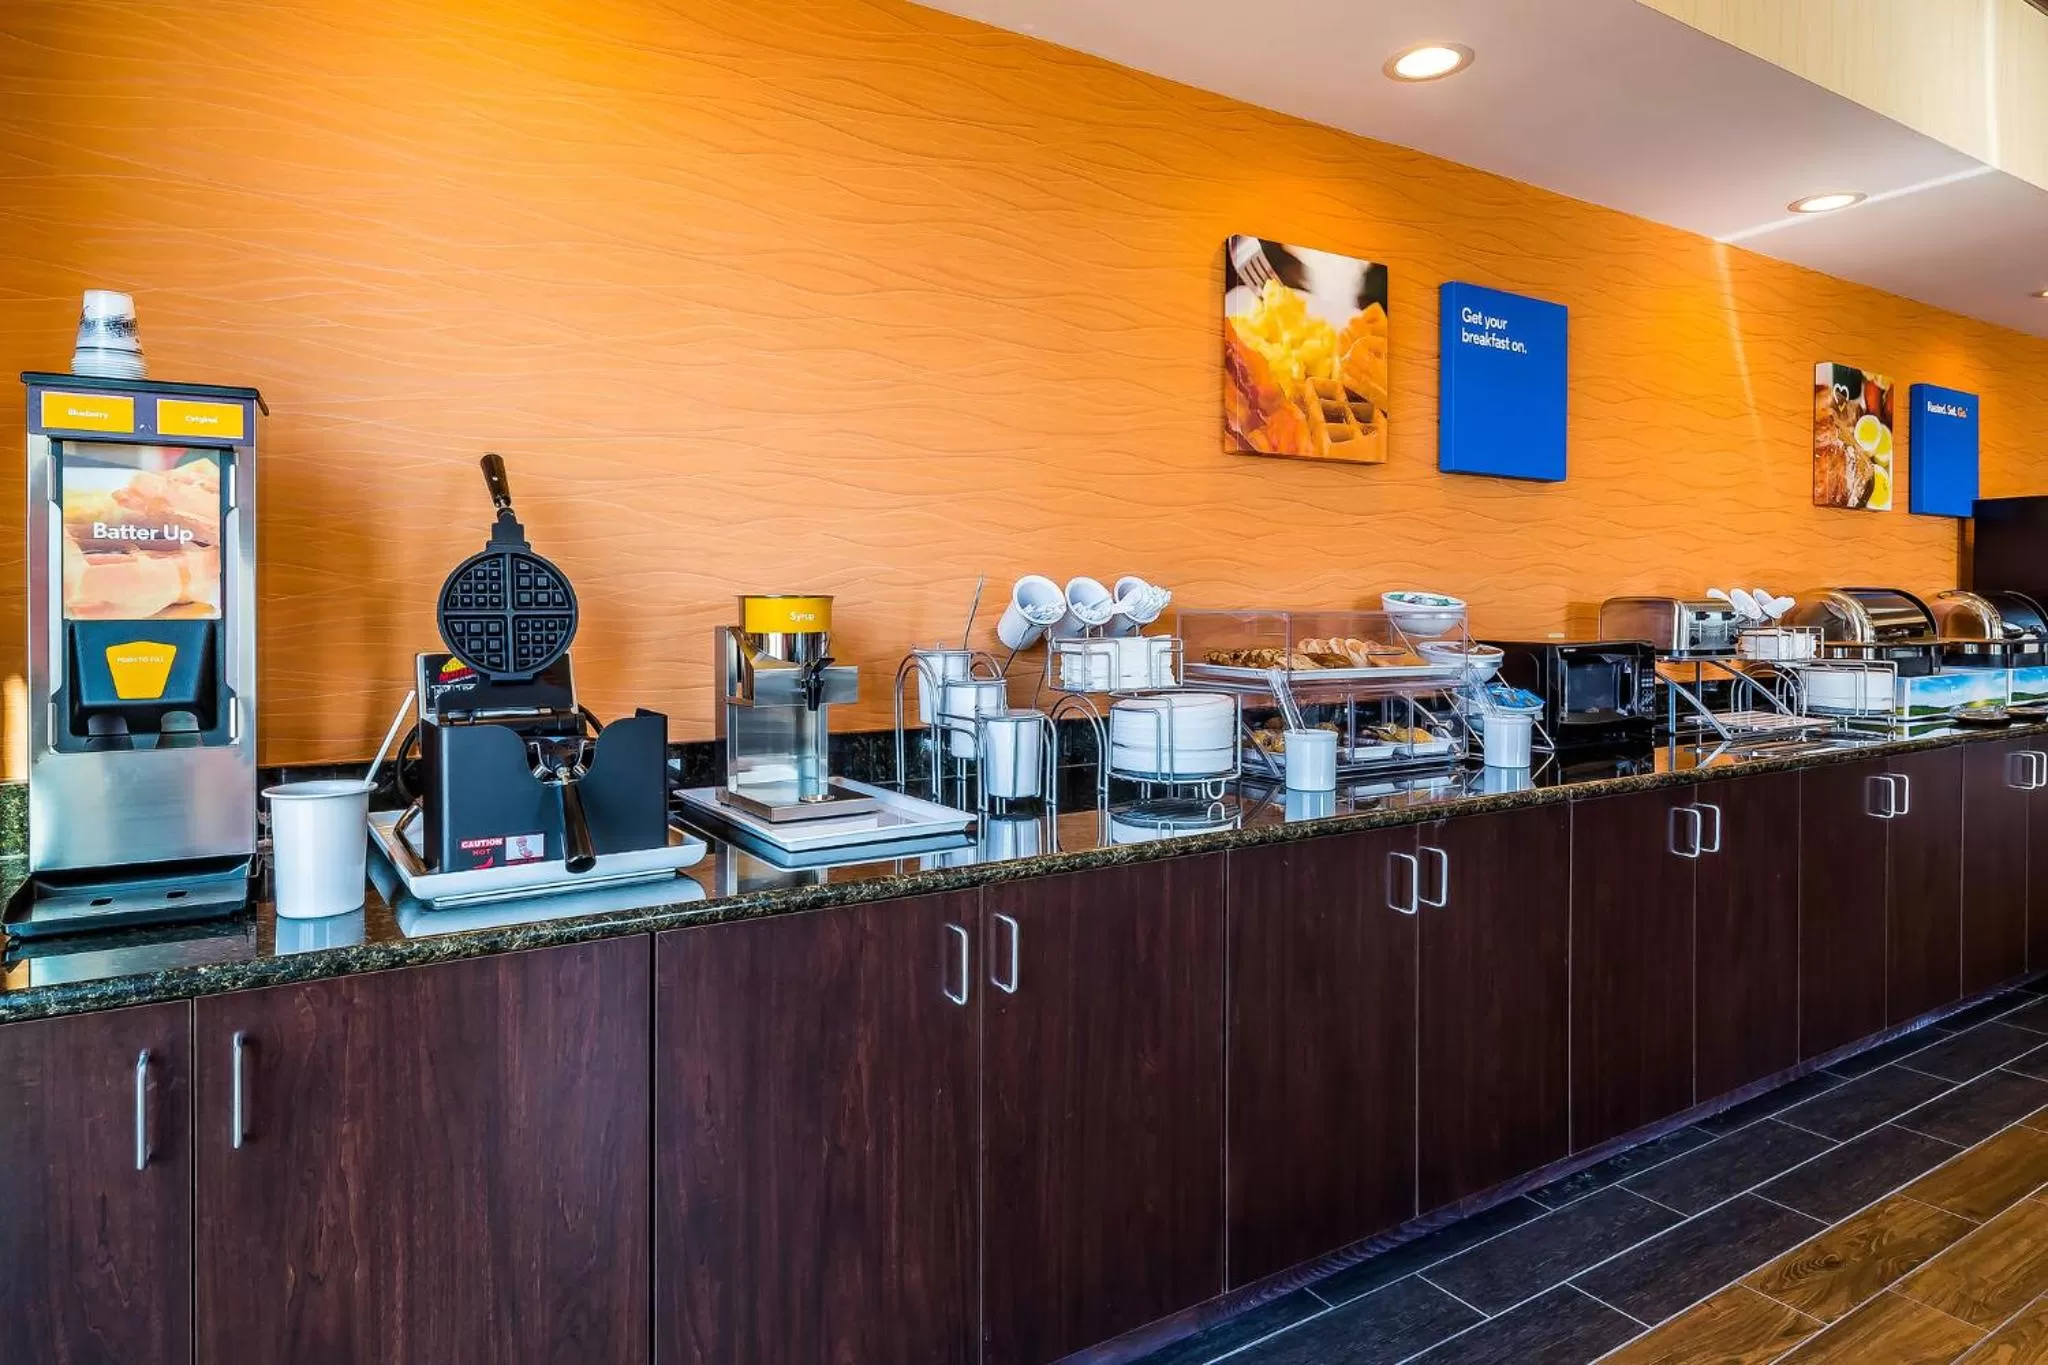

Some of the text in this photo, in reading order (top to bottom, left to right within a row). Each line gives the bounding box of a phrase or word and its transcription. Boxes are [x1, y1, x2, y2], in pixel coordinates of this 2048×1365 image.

[1461, 307, 1508, 330] Get your
[1461, 328, 1527, 354] breakfast on.
[185, 414, 218, 425] Original
[93, 522, 193, 544] Batter Up
[461, 838, 503, 849] CAUTION
[472, 848, 491, 856] HOT
